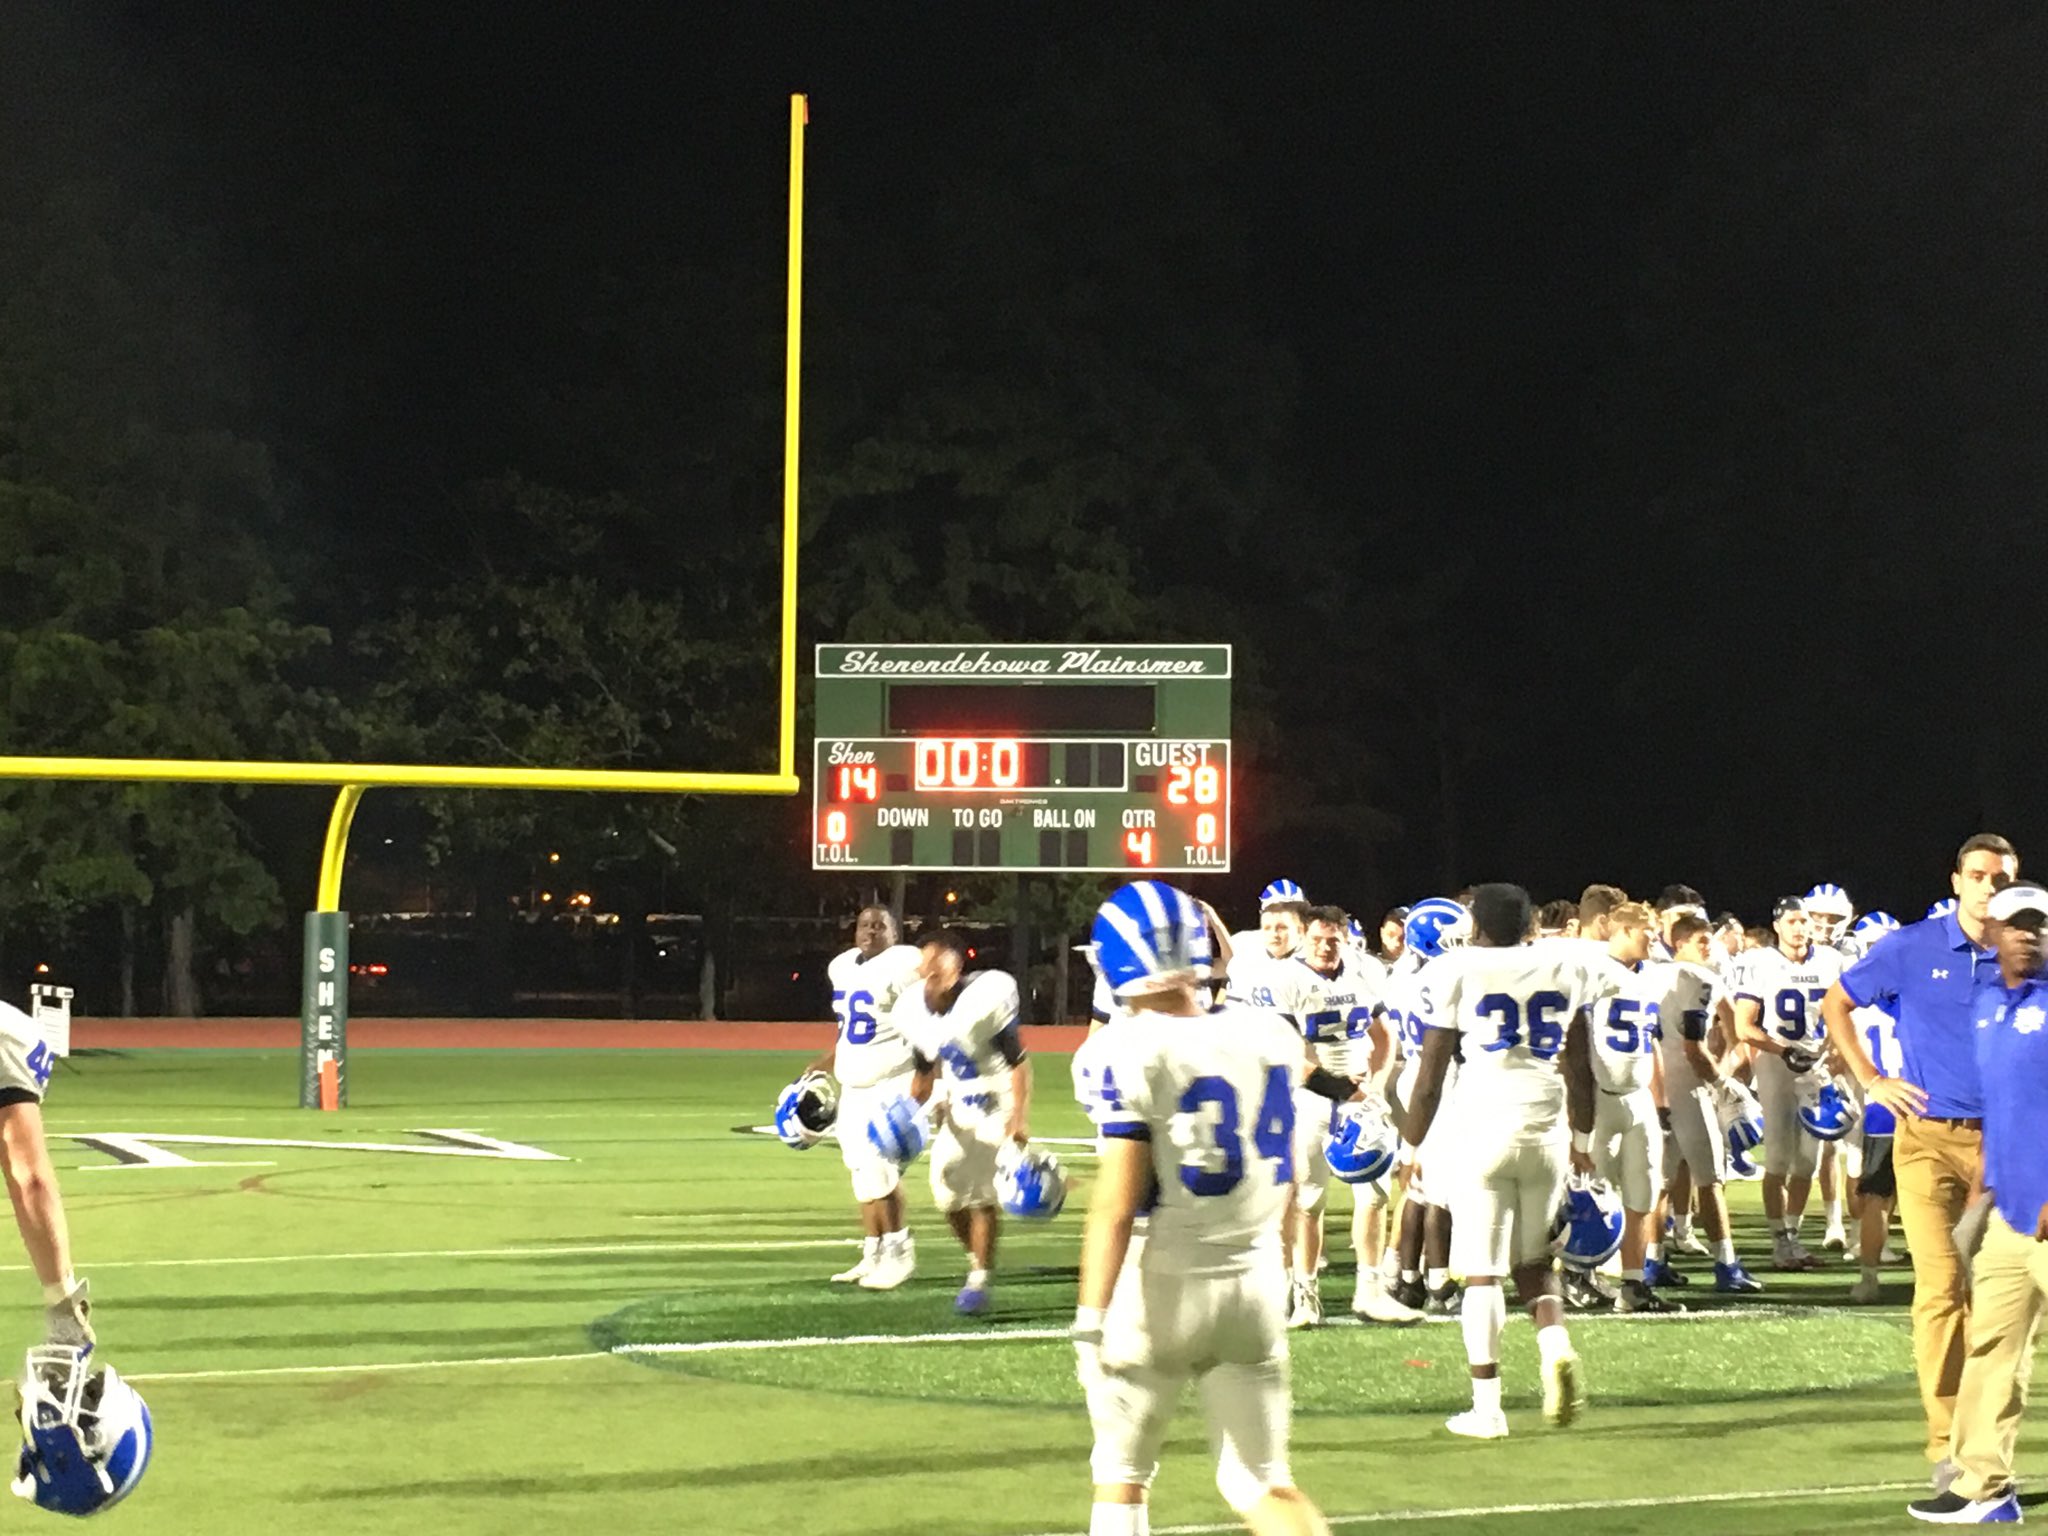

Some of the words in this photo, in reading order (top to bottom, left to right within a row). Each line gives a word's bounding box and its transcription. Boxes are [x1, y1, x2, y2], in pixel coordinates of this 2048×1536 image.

[839, 651, 1051, 673] Shenendehowa
[1057, 650, 1206, 673] Plainsmen
[828, 742, 876, 764] Shen
[1135, 743, 1211, 766] GUEST
[839, 767, 877, 800] 14
[1167, 766, 1218, 804] 28
[827, 811, 846, 842] 0
[877, 808, 929, 827] DOWN
[952, 808, 974, 827] TO
[979, 808, 1002, 828] GO
[1033, 809, 1070, 828] BALL
[1074, 809, 1096, 828] ON
[1122, 809, 1155, 828] QTR
[1196, 813, 1216, 844] 0
[818, 843, 858, 863] T.O.L.
[1127, 831, 1151, 864] 4
[1184, 846, 1226, 865] T.O.L.
[1476, 990, 1568, 1060] 36
[1178, 1064, 1295, 1196] 34
